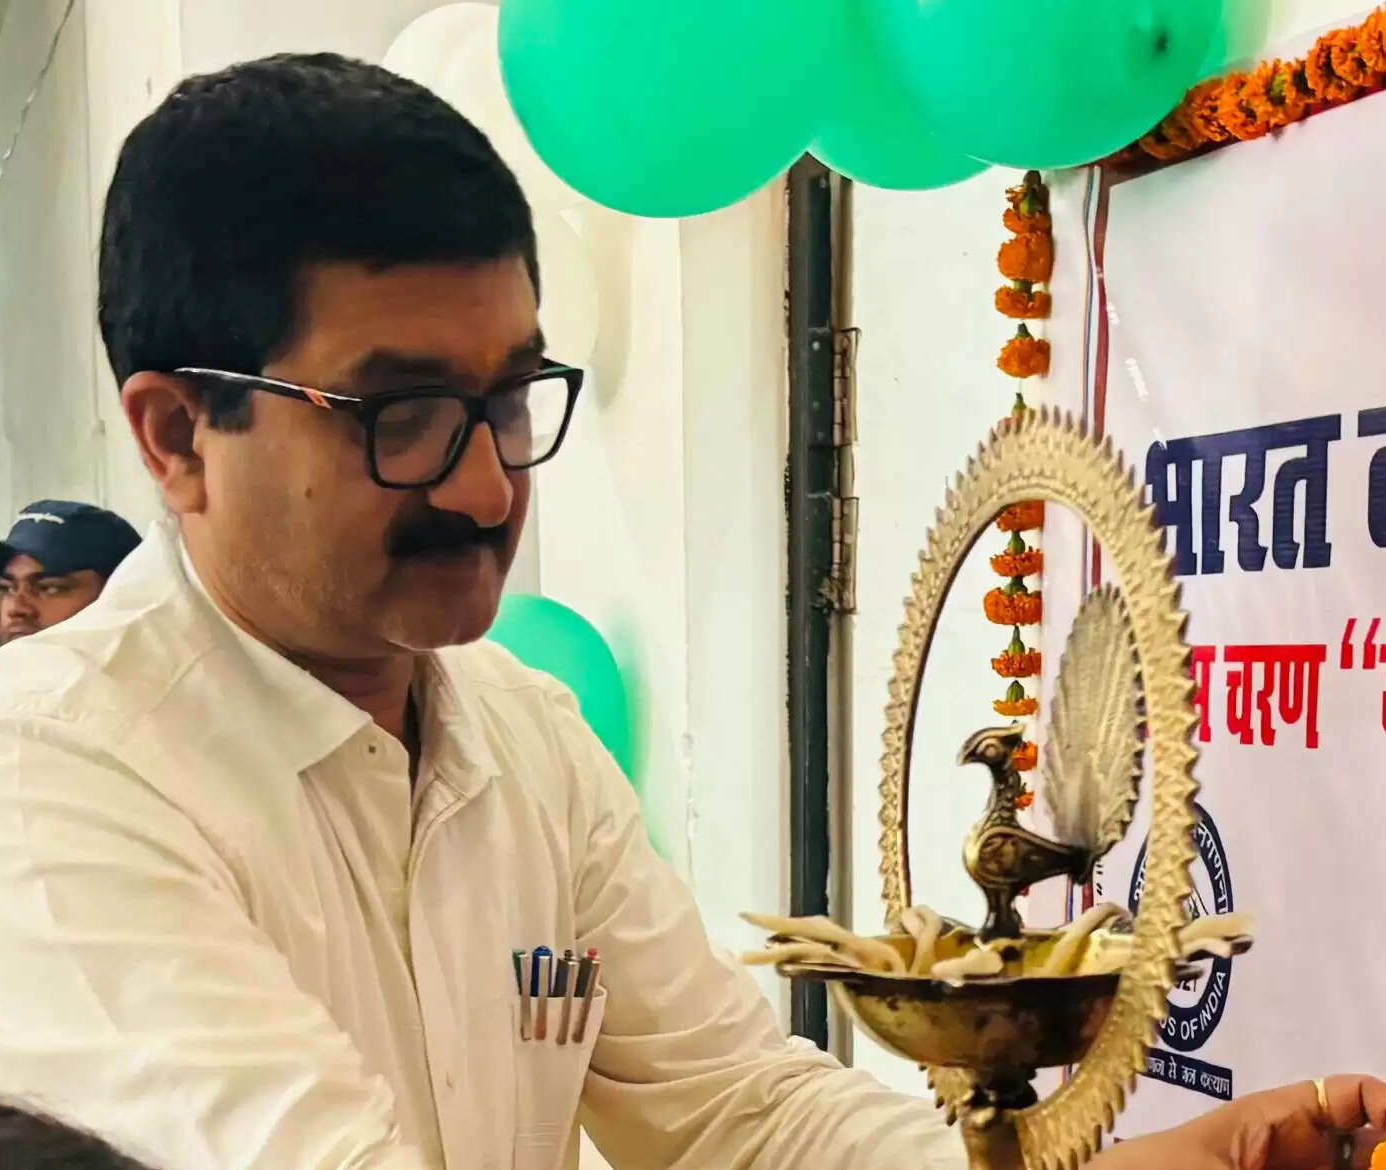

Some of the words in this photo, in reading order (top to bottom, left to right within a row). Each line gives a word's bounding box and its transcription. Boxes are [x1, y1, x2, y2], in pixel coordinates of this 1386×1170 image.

[1145, 413, 1342, 577] भारत
[1223, 643, 1327, 749] चरण
[1180, 1014, 1199, 1042] OF
[1199, 969, 1227, 1032] INDIA
